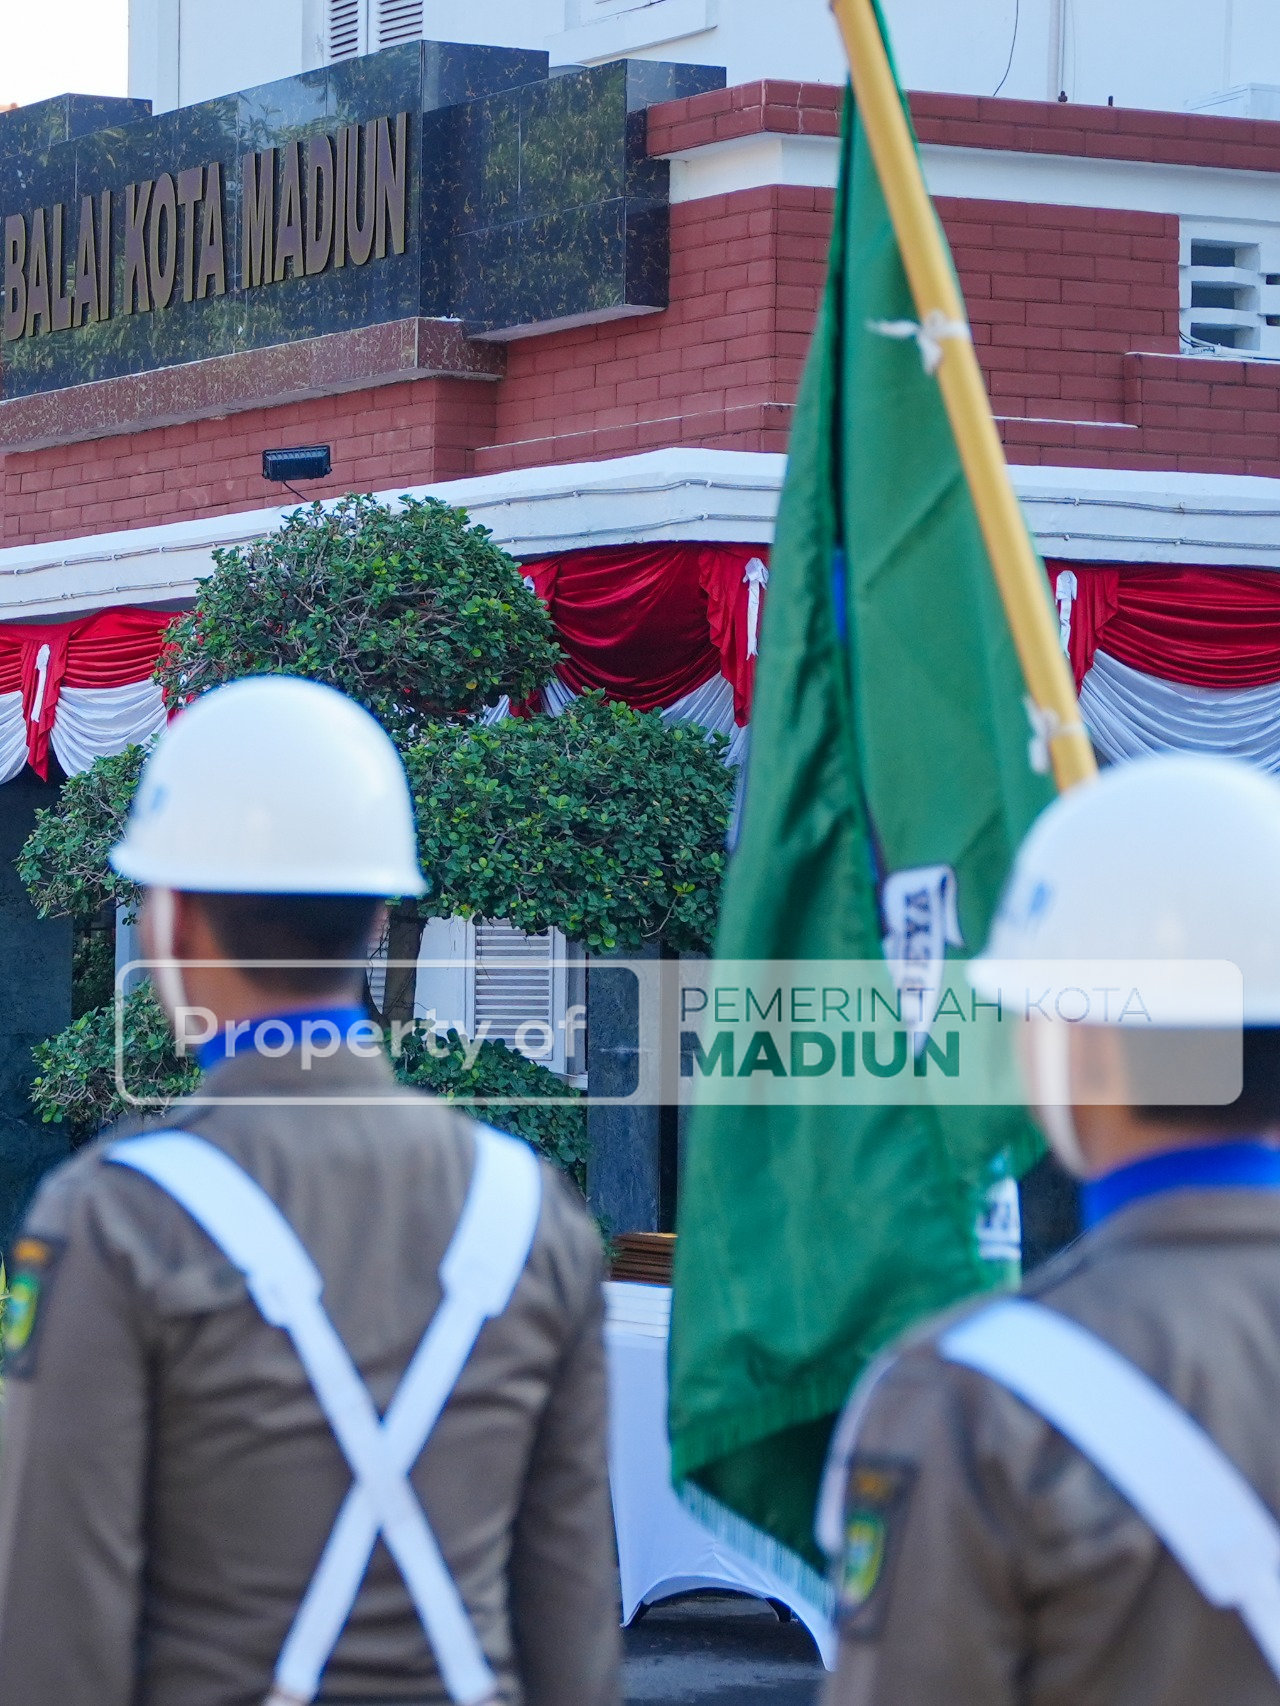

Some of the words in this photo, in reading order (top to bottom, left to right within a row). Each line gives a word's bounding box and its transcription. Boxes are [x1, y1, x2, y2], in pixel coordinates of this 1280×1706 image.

[4, 190, 111, 341] BALAI
[123, 162, 226, 315] KOTA
[241, 112, 408, 290] MADIUN
